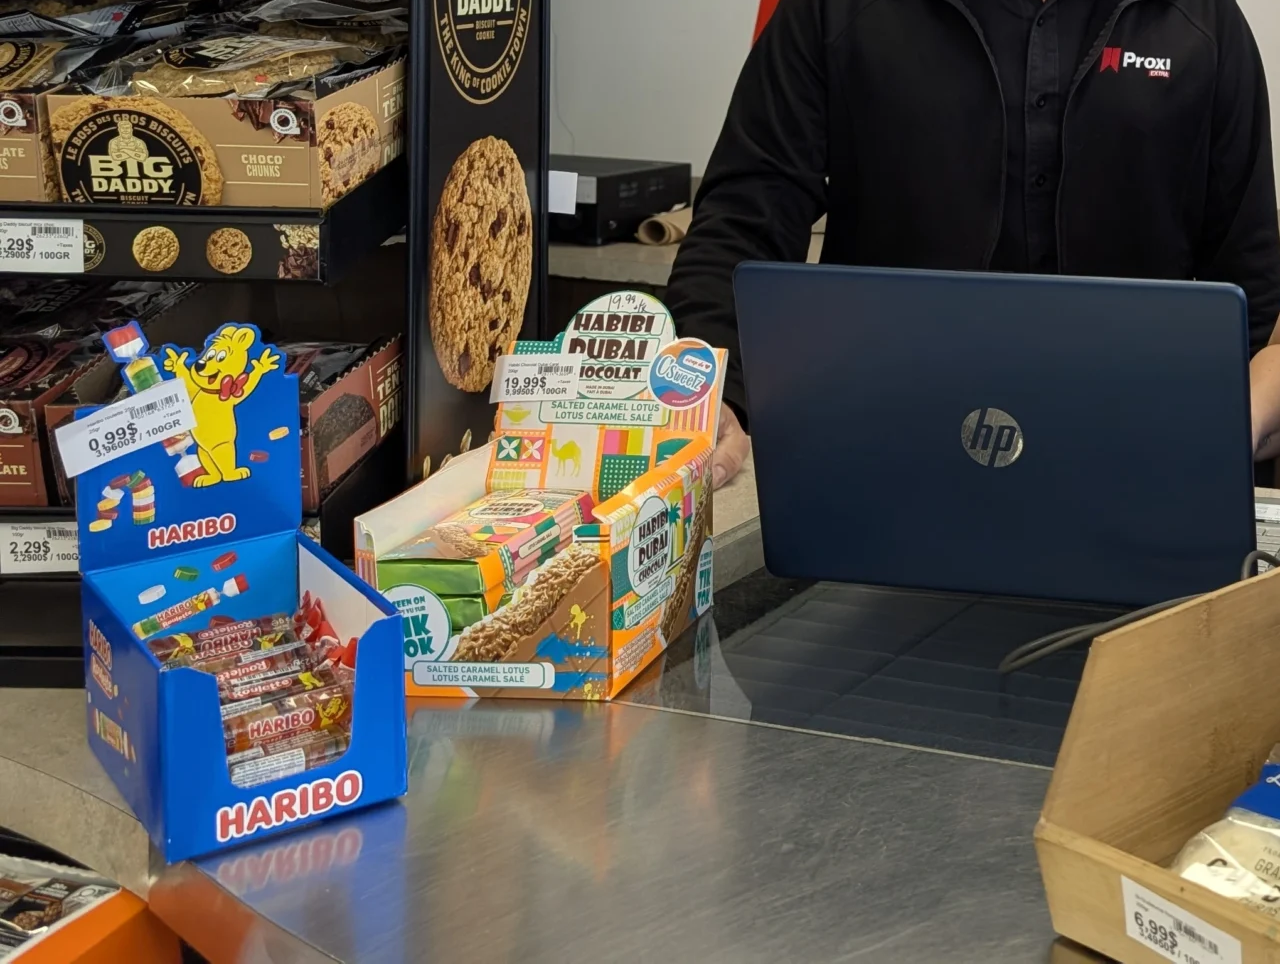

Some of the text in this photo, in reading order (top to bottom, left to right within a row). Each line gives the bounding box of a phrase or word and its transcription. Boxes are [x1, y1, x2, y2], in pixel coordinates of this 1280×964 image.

[475, 19, 496, 30] BISCUIT
[475, 29, 495, 41] COOKIE
[1123, 51, 1171, 71] Proxi
[88, 154, 174, 178] BIG
[241, 154, 283, 165] CHOCO
[246, 164, 281, 178] CHUNKS
[91, 177, 175, 194] DADDY
[39, 251, 70, 259] 100GR
[572, 312, 656, 333] HABIBI
[567, 337, 650, 361] DUBAI
[504, 376, 548, 390] 19,99$
[505, 386, 568, 397] 9,9950$ 100GR
[550, 400, 660, 413] SALTED CARAMEL LOTUS
[554, 410, 654, 422] LOTUS CARAMEL SALÉ
[88, 422, 139, 452] 0,99$
[95, 417, 183, 458] 3,9600$ 100GR
[969, 407, 1018, 467] hp
[148, 513, 236, 549] HARIBO
[638, 507, 669, 543] HABIBI
[9, 540, 51, 556] 2,29$
[638, 530, 669, 567] DUBAI
[638, 553, 668, 582] CHOCOLAT
[403, 613, 432, 638] IK
[403, 636, 436, 658] OK
[427, 665, 530, 675] SALTED CARAMEL LOTUS
[432, 672, 525, 683] LOTUS CARAMEL SALÉ
[248, 708, 316, 738] HARIBO
[216, 770, 363, 842] HARIBO
[1134, 910, 1179, 950] 6,99$
